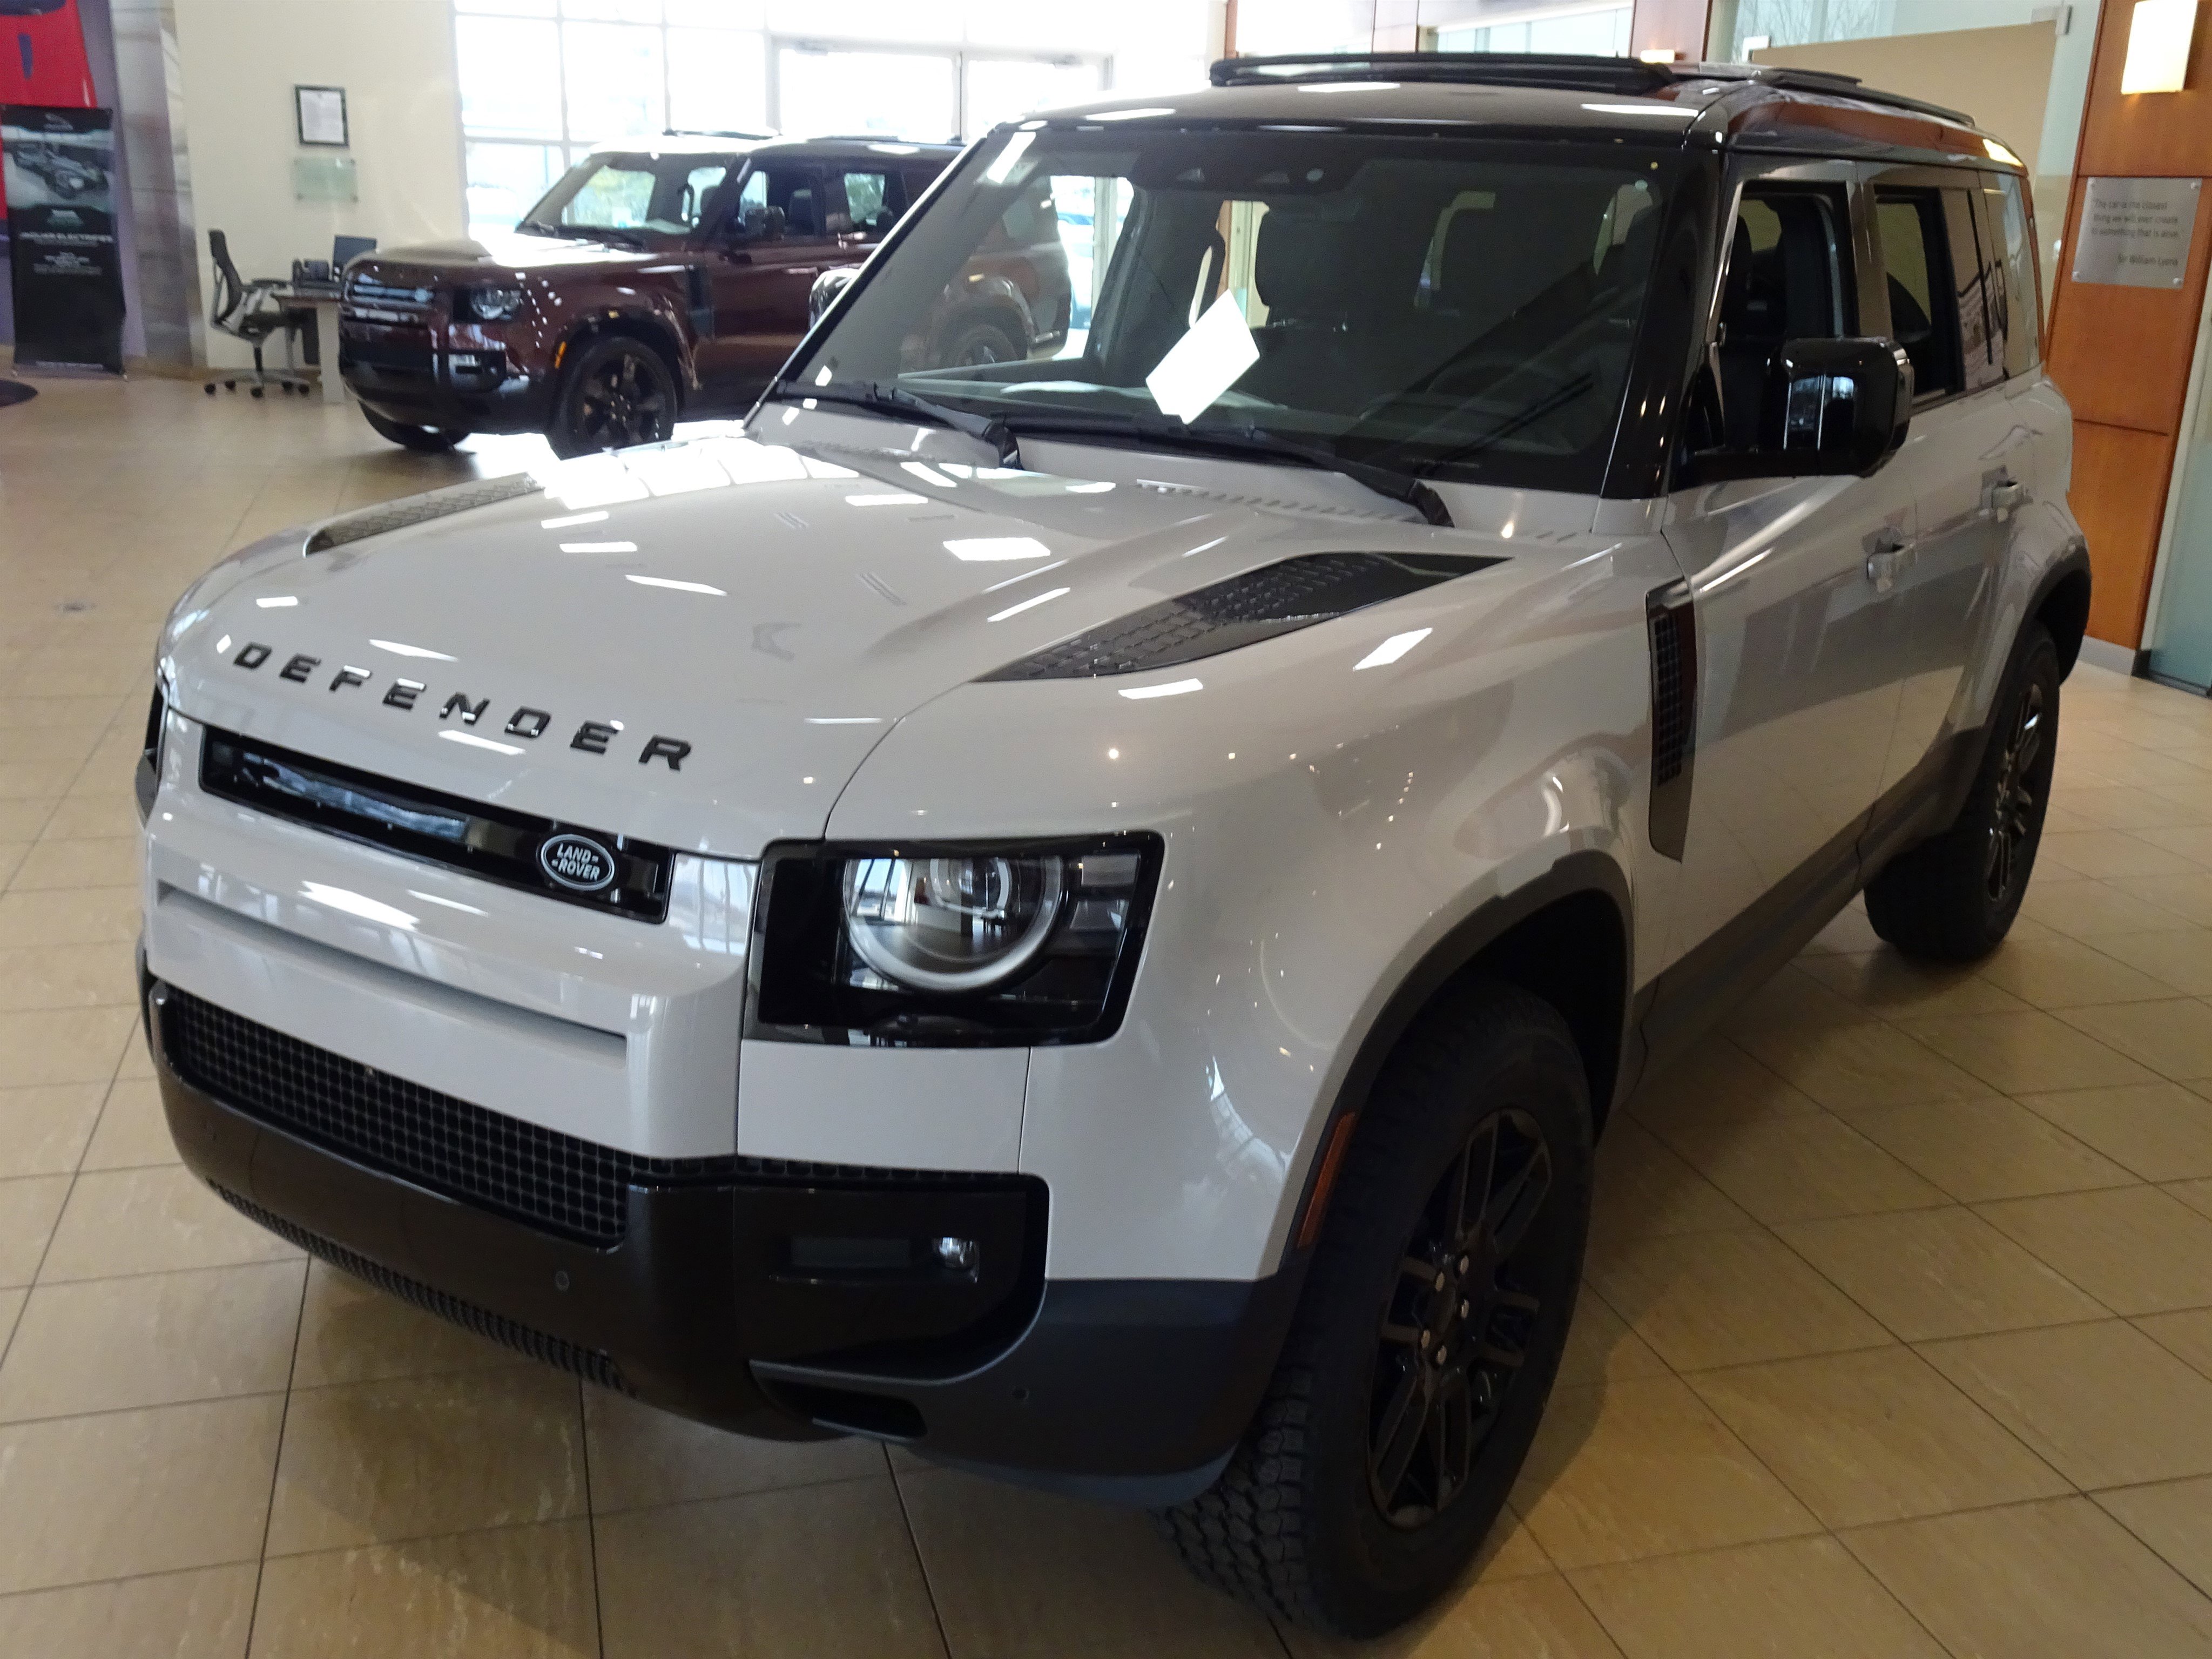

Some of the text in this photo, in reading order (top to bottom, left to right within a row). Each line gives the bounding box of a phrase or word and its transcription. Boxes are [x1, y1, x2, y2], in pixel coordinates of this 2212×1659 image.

[234, 642, 693, 771] DEFENDER
[557, 842, 592, 864] LAND
[558, 857, 601, 881] ROVER
